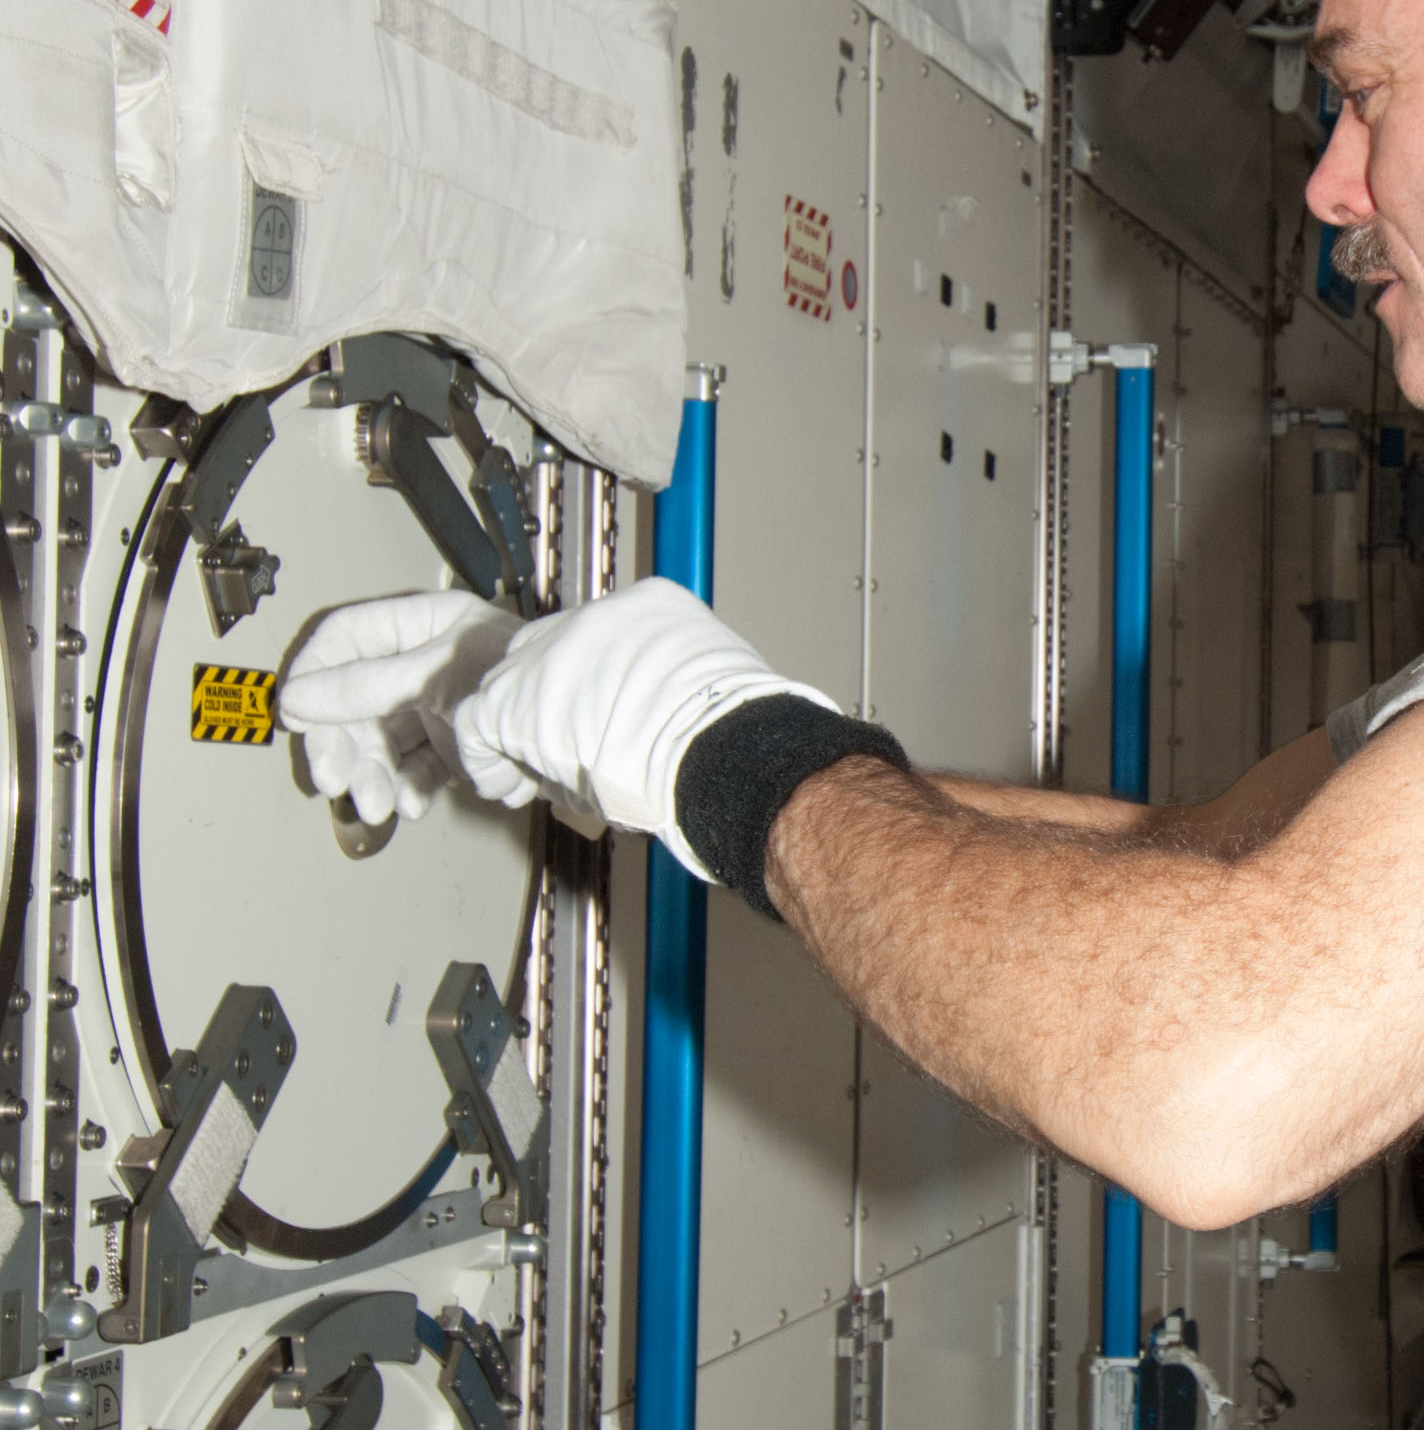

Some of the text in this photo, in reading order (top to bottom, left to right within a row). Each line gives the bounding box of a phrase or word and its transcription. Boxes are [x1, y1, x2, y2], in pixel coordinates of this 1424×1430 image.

[204, 684, 243, 700] WARNING
[203, 698, 243, 714] COLD INSIDE
[103, 1397, 112, 1414] B
